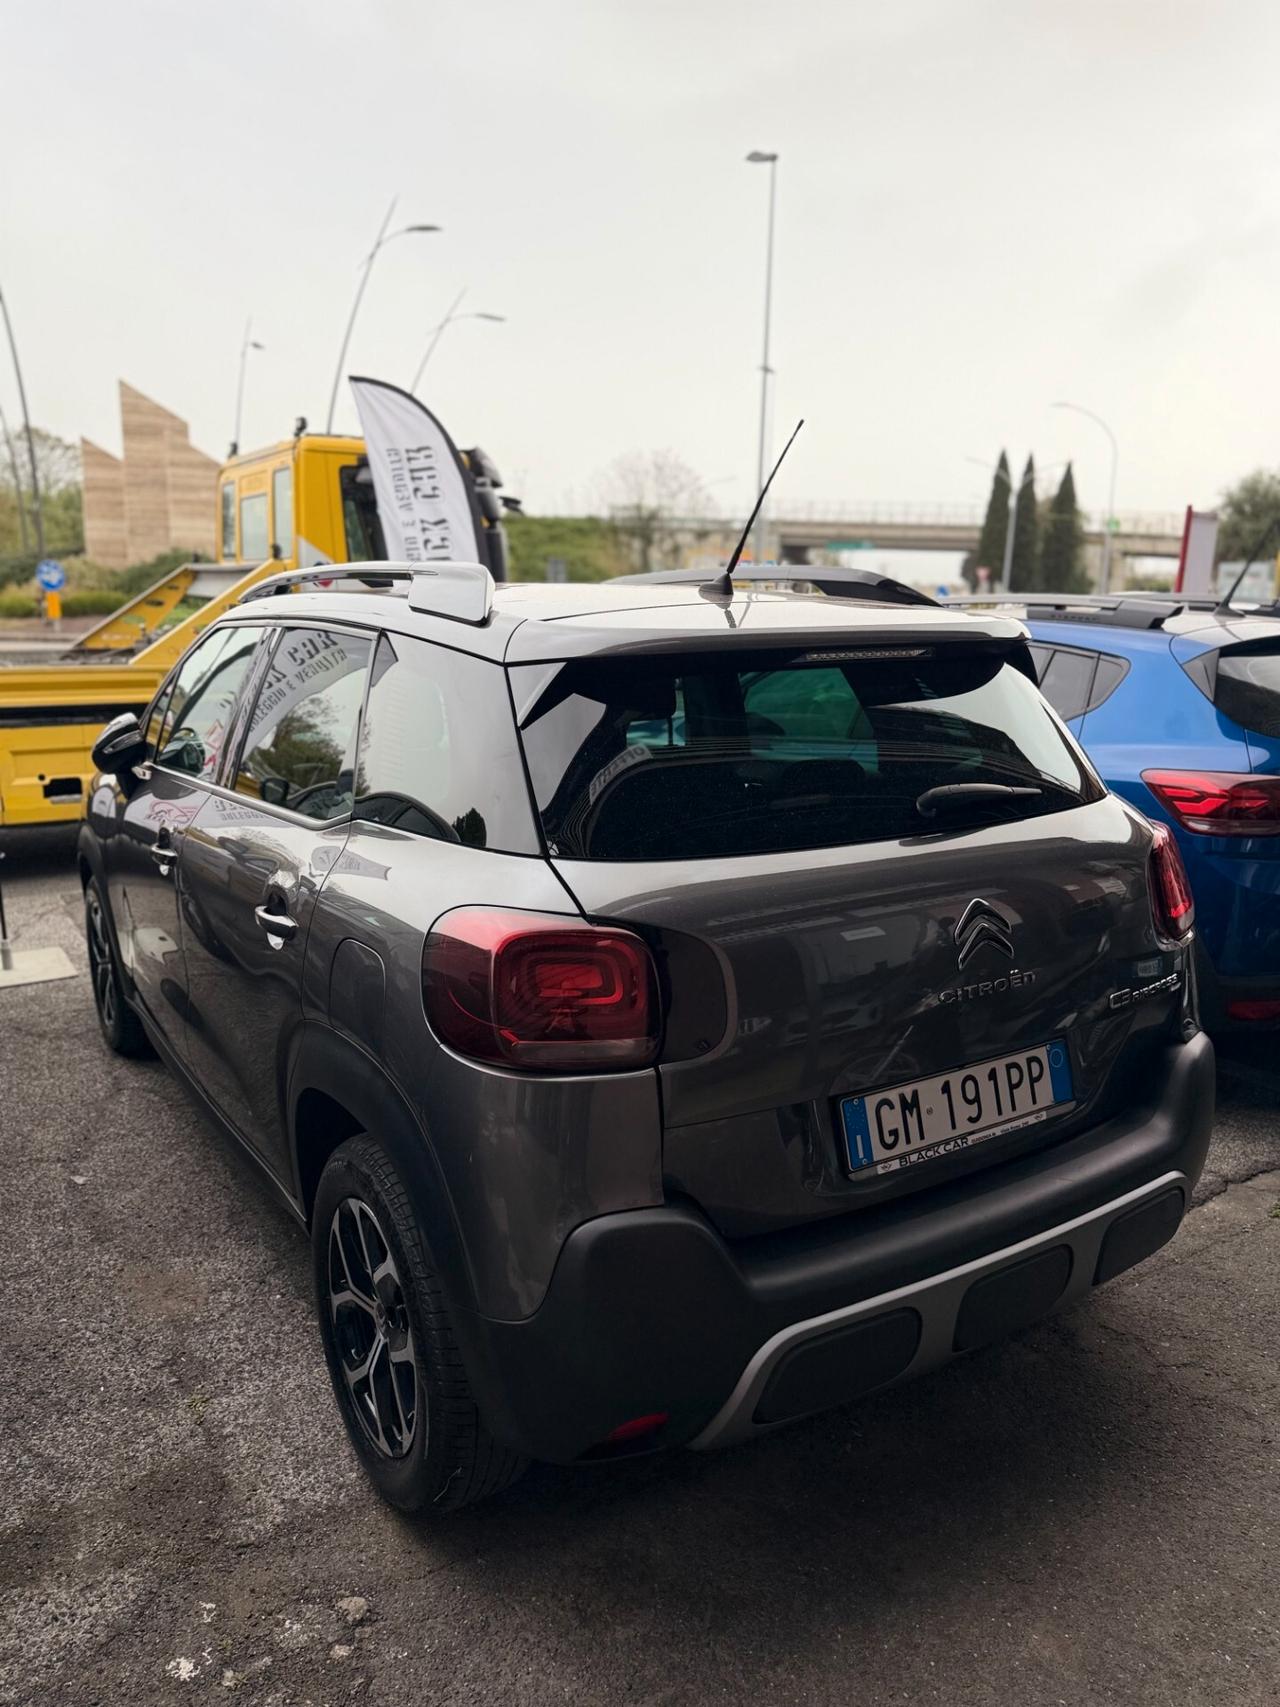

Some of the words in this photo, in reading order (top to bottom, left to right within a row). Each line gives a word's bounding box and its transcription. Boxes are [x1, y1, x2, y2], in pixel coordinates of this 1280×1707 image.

[940, 968, 1036, 1004] CITROËN
[874, 1088, 926, 1151] GM
[941, 1055, 1045, 1130] 191PP
[899, 1148, 941, 1168] BLACK
[943, 1137, 969, 1153] CAR
